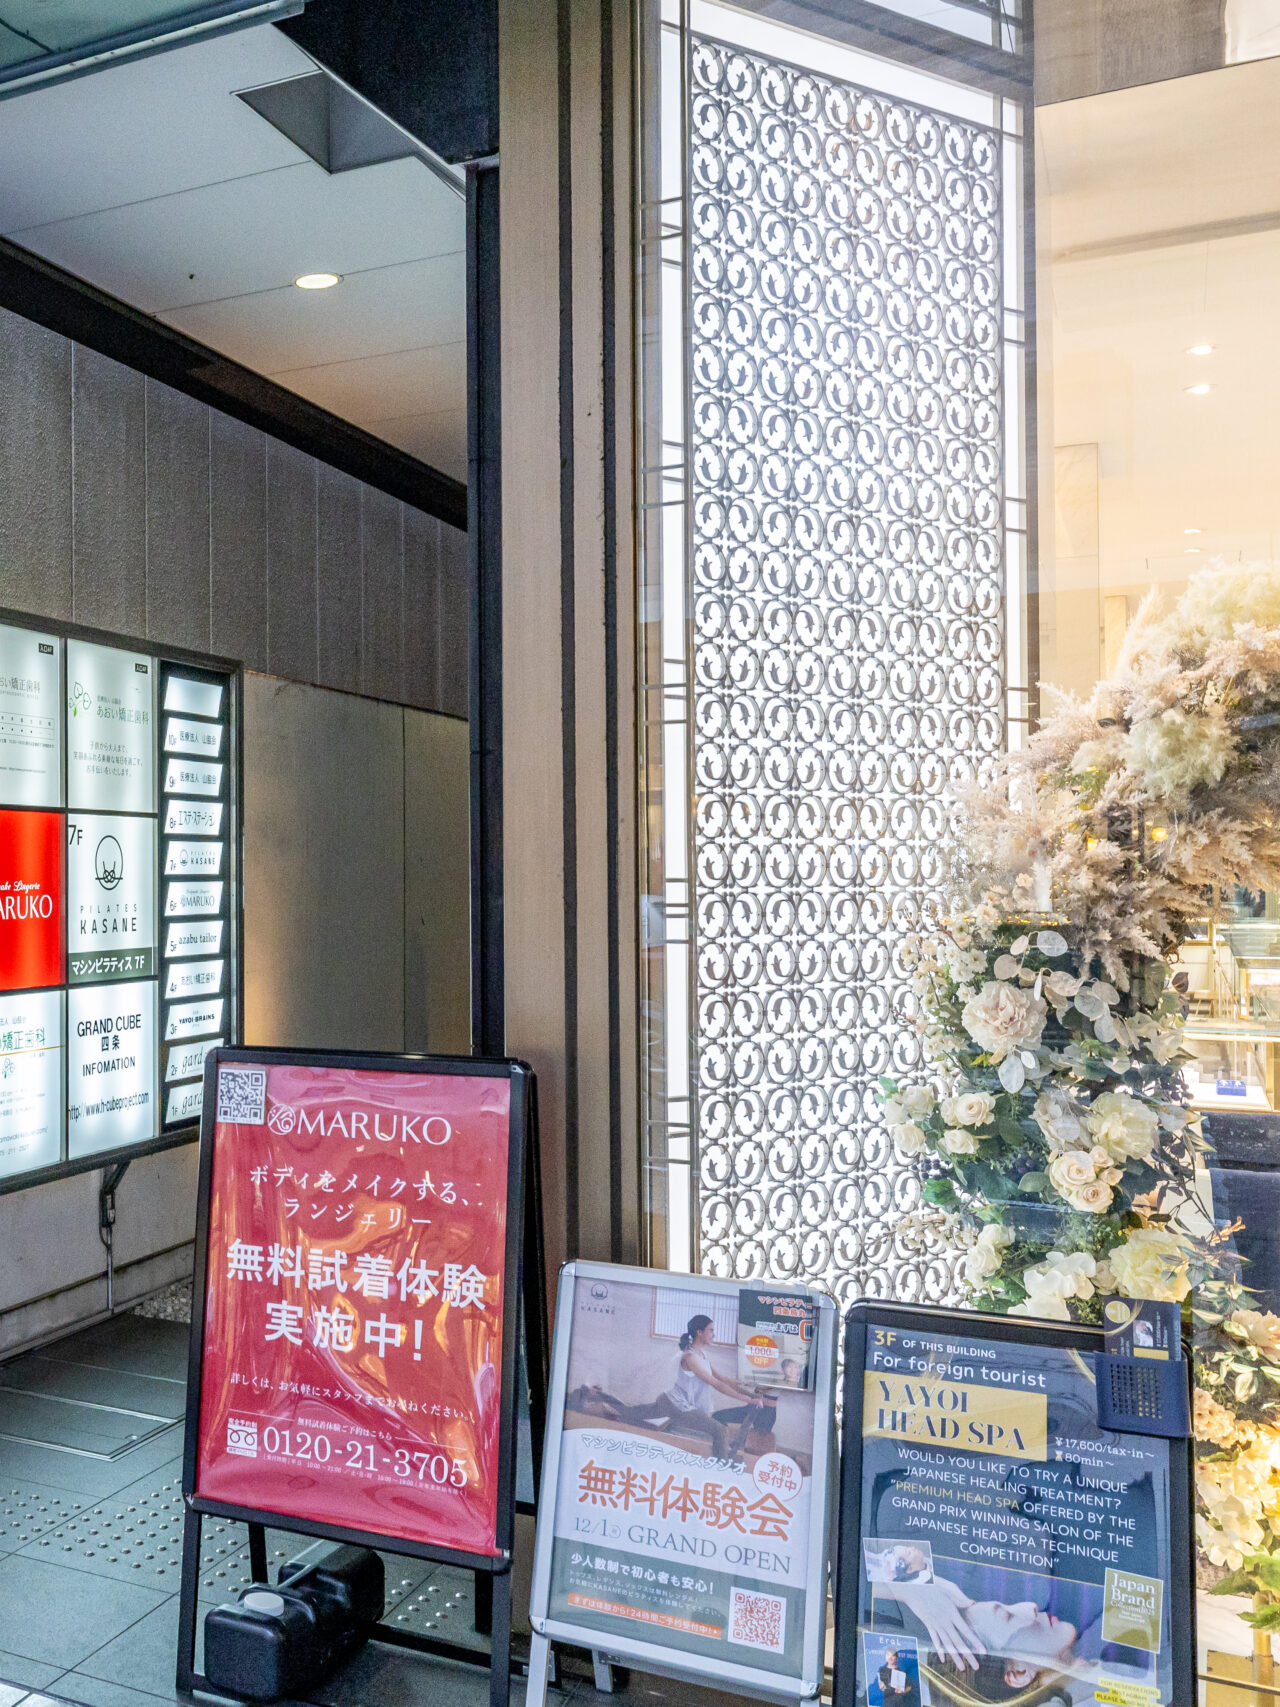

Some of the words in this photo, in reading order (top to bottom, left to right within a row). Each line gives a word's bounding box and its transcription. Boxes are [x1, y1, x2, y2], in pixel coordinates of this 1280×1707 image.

[96, 705, 149, 725] あおい矯正歯科
[169, 776, 176, 788] 9F
[169, 817, 177, 829] 8F
[68, 824, 83, 846] 7F
[169, 859, 177, 872] 7F
[190, 857, 216, 865] KASANE
[13, 880, 41, 894] Lingerie
[80, 904, 137, 914] PILATES
[169, 900, 177, 911] 6F
[186, 895, 215, 907] MARUKO
[80, 917, 137, 934] KASANE
[170, 940, 177, 952] 5F
[179, 934, 198, 945] azabu
[199, 932, 217, 943] tailor
[72, 957, 132, 976] マシンピラティス
[135, 955, 145, 969] 7F
[170, 982, 177, 993] 4F
[77, 1018, 113, 1038] GRAND
[115, 1014, 142, 1032] CUBE
[170, 1023, 178, 1035] 3F
[101, 1036, 120, 1052] 四条
[82, 1056, 136, 1077] INFOMATION
[170, 1064, 178, 1076] 2F
[171, 1104, 179, 1116] 1F
[297, 1110, 451, 1145] MARUKO
[250, 1166, 470, 1206] ボディをメイクする、
[283, 1198, 432, 1229] ランジェリー
[226, 1238, 487, 1310] 無料試着体験
[874, 1330, 897, 1346] 3F
[902, 1339, 916, 1349] OF
[920, 1341, 944, 1352] THIS
[947, 1344, 996, 1359] BUILDING
[873, 1352, 902, 1368] For
[908, 1356, 974, 1380] foreign
[981, 1366, 1047, 1388] tourist
[879, 1380, 968, 1413] YAYOI
[878, 1408, 960, 1439] HEAD
[968, 1421, 1025, 1450] SPA
[263, 1426, 468, 1487] 0120-21-3705
[581, 1434, 747, 1475] マシンピラティススタジオ
[768, 1460, 793, 1478] 予約
[898, 1448, 944, 1464] WOULD
[948, 1455, 975, 1469] YOU
[979, 1461, 1007, 1475] LIKE
[1010, 1465, 1030, 1478] TO
[1034, 1469, 1059, 1482] TRY
[1063, 1474, 1072, 1485] A
[1076, 1476, 1128, 1493] UNIQUE
[758, 1471, 797, 1492] 受付中
[904, 1466, 966, 1485] JAPANESE
[970, 1476, 1027, 1494] HEALING
[1032, 1485, 1121, 1509] TREATMENT?
[578, 1459, 793, 1541] 無料体験会
[957, 1491, 992, 1505] HEAD
[995, 1497, 1020, 1511] SPA
[1023, 1501, 1084, 1521] OFFERED
[1088, 1512, 1105, 1525] BY
[1109, 1515, 1136, 1530] THE
[892, 1496, 935, 1513] GRAND
[940, 1504, 967, 1519] PRIX
[971, 1510, 1030, 1529] WINNING
[1034, 1521, 1079, 1538] SALON
[1083, 1529, 1102, 1541] OF
[1107, 1532, 1134, 1548] THE
[628, 1525, 717, 1558] GRAND
[724, 1544, 791, 1575] OPEN
[905, 1516, 968, 1536] JAPANESE
[972, 1528, 1007, 1542] HEAD
[1011, 1534, 1036, 1548] SPA
[1040, 1538, 1119, 1562] TECHNIQUE
[1111, 1572, 1155, 1594] Japan
[1111, 1588, 1155, 1609] Brand
